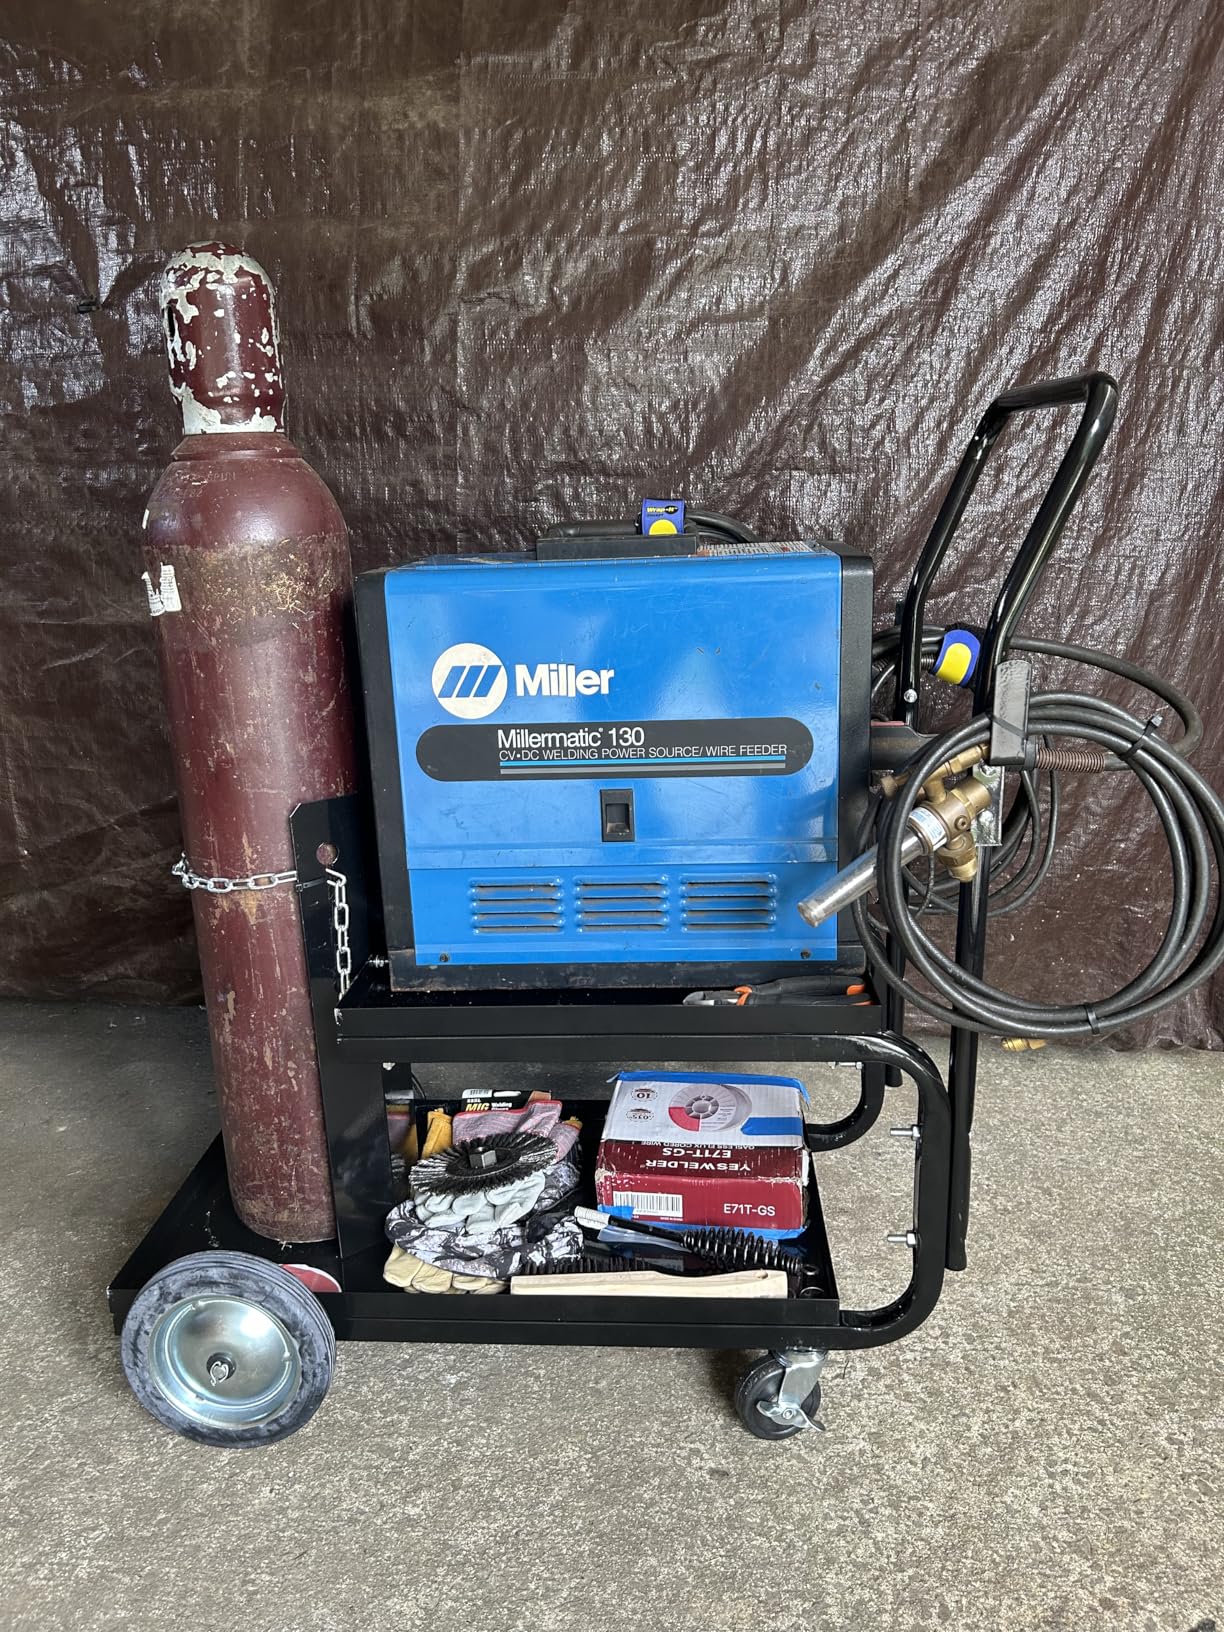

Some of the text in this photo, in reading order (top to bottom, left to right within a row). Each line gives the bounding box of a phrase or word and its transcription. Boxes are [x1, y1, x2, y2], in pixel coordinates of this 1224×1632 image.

[515, 664, 615, 697] Miller
[608, 727, 645, 746] 130
[542, 749, 598, 760] WELDING
[601, 748, 646, 759] POWER
[648, 746, 703, 758] SOURCE/
[705, 745, 737, 757] WIRE
[740, 744, 787, 756] FEEDER
[662, 1147, 731, 1159] E71T-GS
[723, 1203, 776, 1216] E71T-GS
